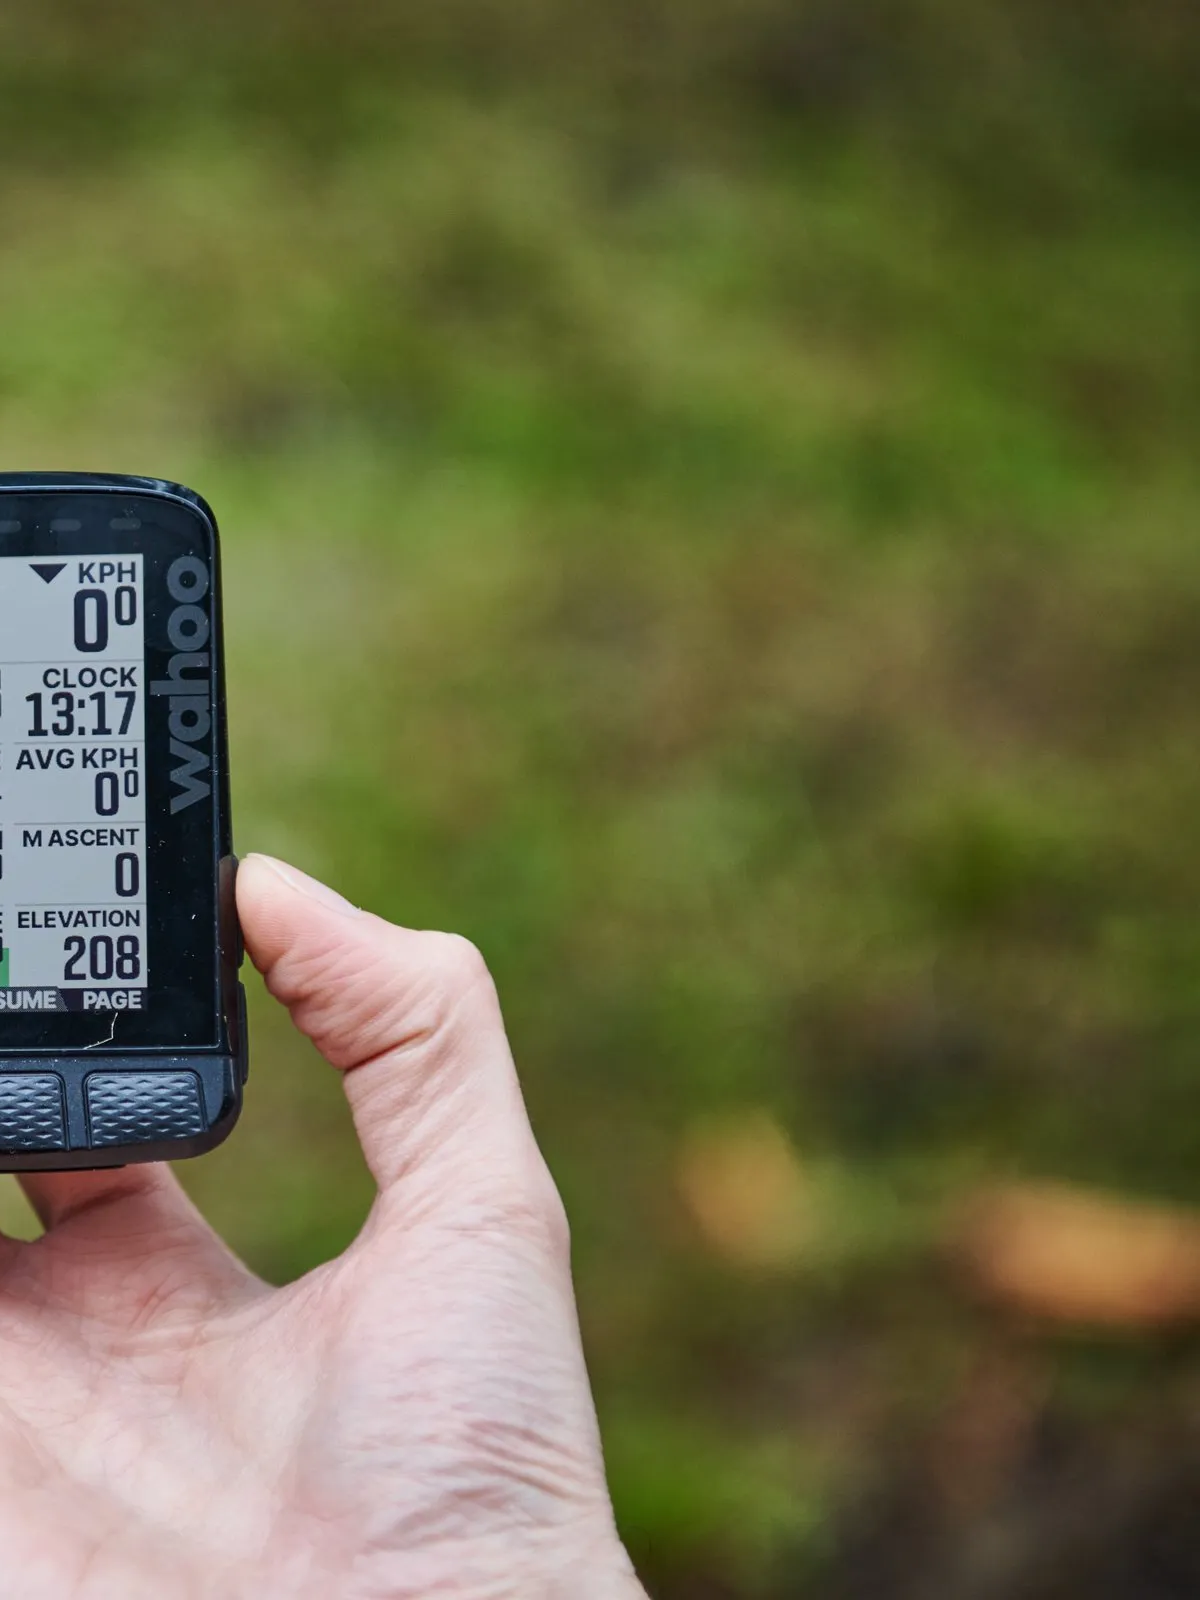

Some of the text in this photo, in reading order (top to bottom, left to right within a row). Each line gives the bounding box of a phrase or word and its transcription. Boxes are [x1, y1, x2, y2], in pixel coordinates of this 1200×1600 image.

[78, 562, 137, 584] KPH
[43, 668, 137, 688] CLOCK
[150, 555, 210, 815] wahoo
[26, 692, 137, 736] 13:17
[16, 749, 138, 769] AVG KPH
[22, 829, 139, 848] M ASCENT
[114, 852, 139, 897] 0
[17, 911, 139, 928] ELEVATION
[64, 936, 140, 981] 208
[83, 992, 141, 1009] PAGE
